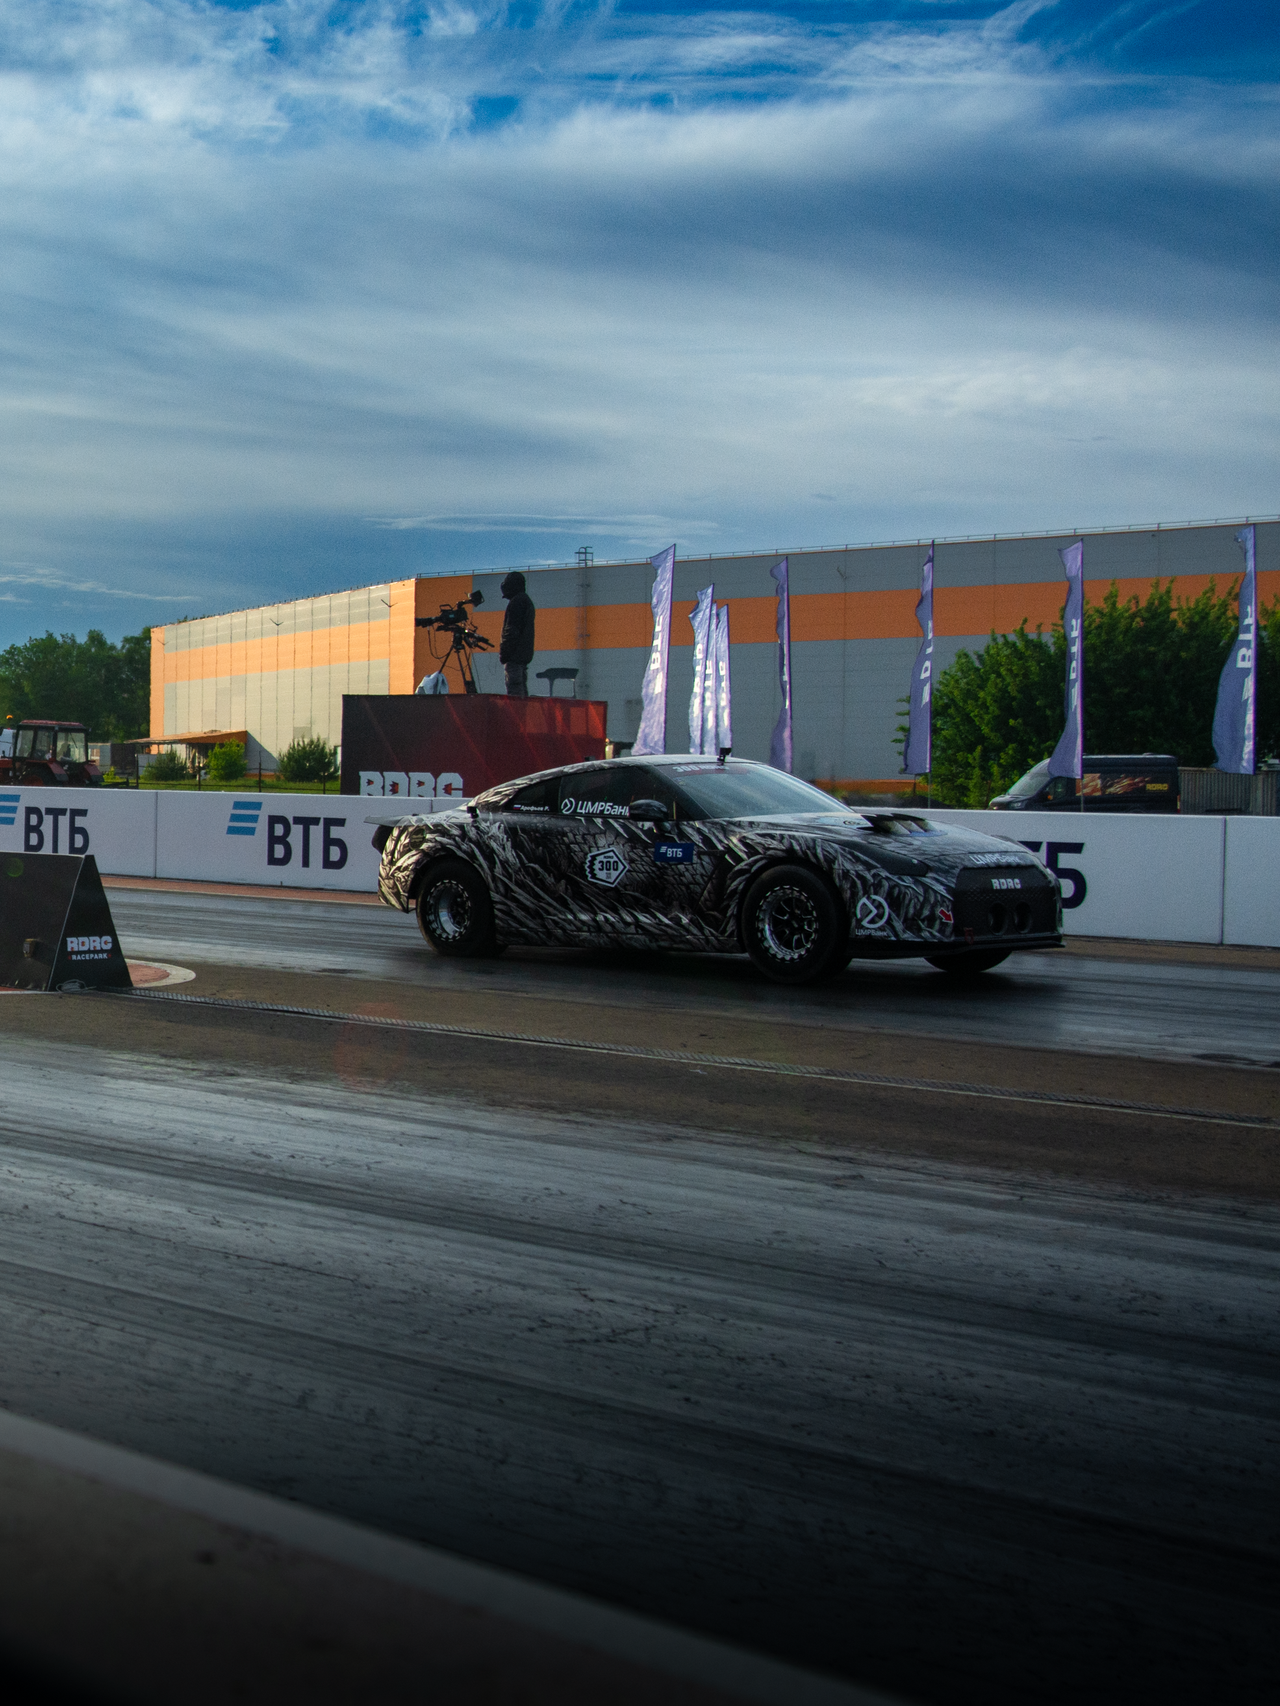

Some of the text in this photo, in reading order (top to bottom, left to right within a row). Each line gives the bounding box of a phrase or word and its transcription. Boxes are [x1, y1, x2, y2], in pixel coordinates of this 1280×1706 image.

[359, 770, 464, 798] RDRC
[23, 806, 89, 855] ВТБ
[267, 814, 348, 870] ВТБ
[666, 848, 683, 858] ВТБ
[598, 860, 619, 871] 300
[990, 878, 1021, 890] RDRC
[66, 935, 113, 952] RDRC
[71, 953, 108, 961] RACEPARK
